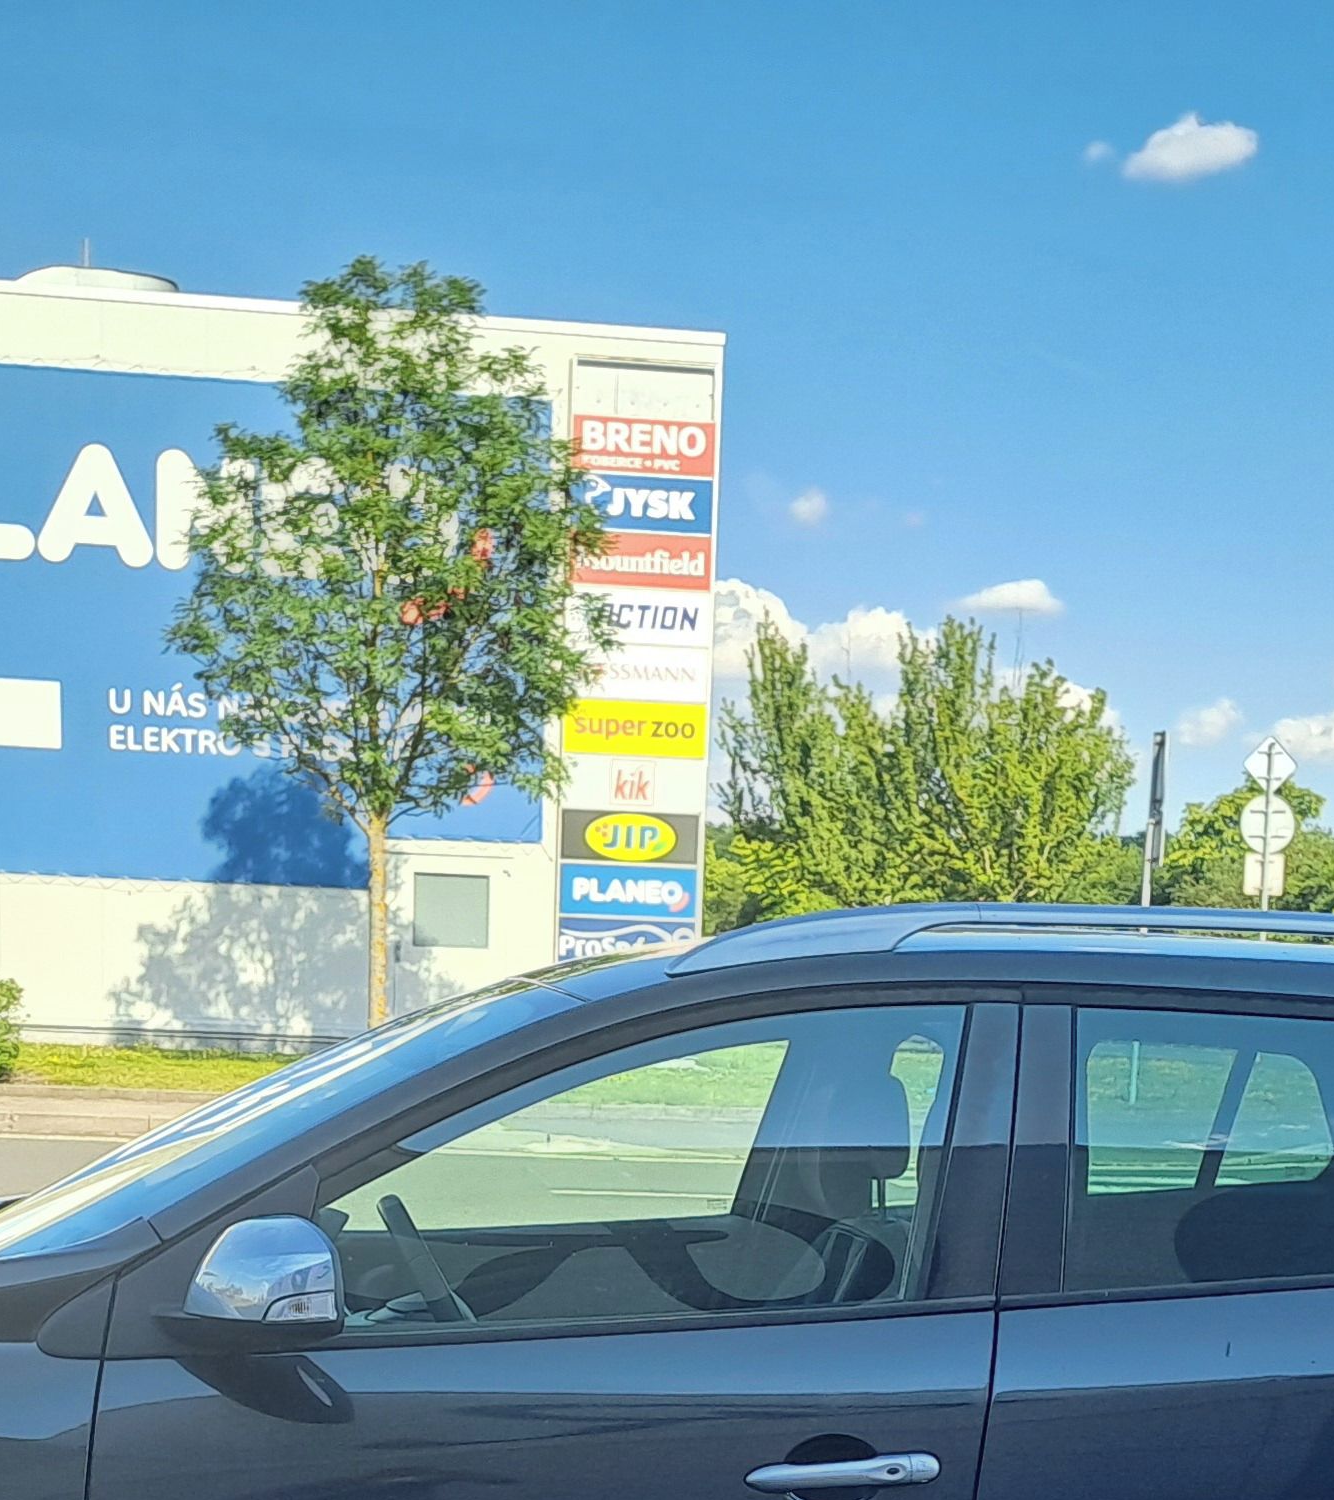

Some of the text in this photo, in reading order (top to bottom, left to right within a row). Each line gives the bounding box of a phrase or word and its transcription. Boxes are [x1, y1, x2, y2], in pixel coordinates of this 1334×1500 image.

[581, 419, 707, 458] BRENO
[607, 487, 696, 520] JYSK
[579, 661, 696, 682] SSMANN
[108, 686, 132, 715] U
[142, 681, 208, 719] NÁS
[614, 769, 650, 801] kik
[603, 824, 660, 850] JIP
[572, 876, 683, 905] PLANEO
